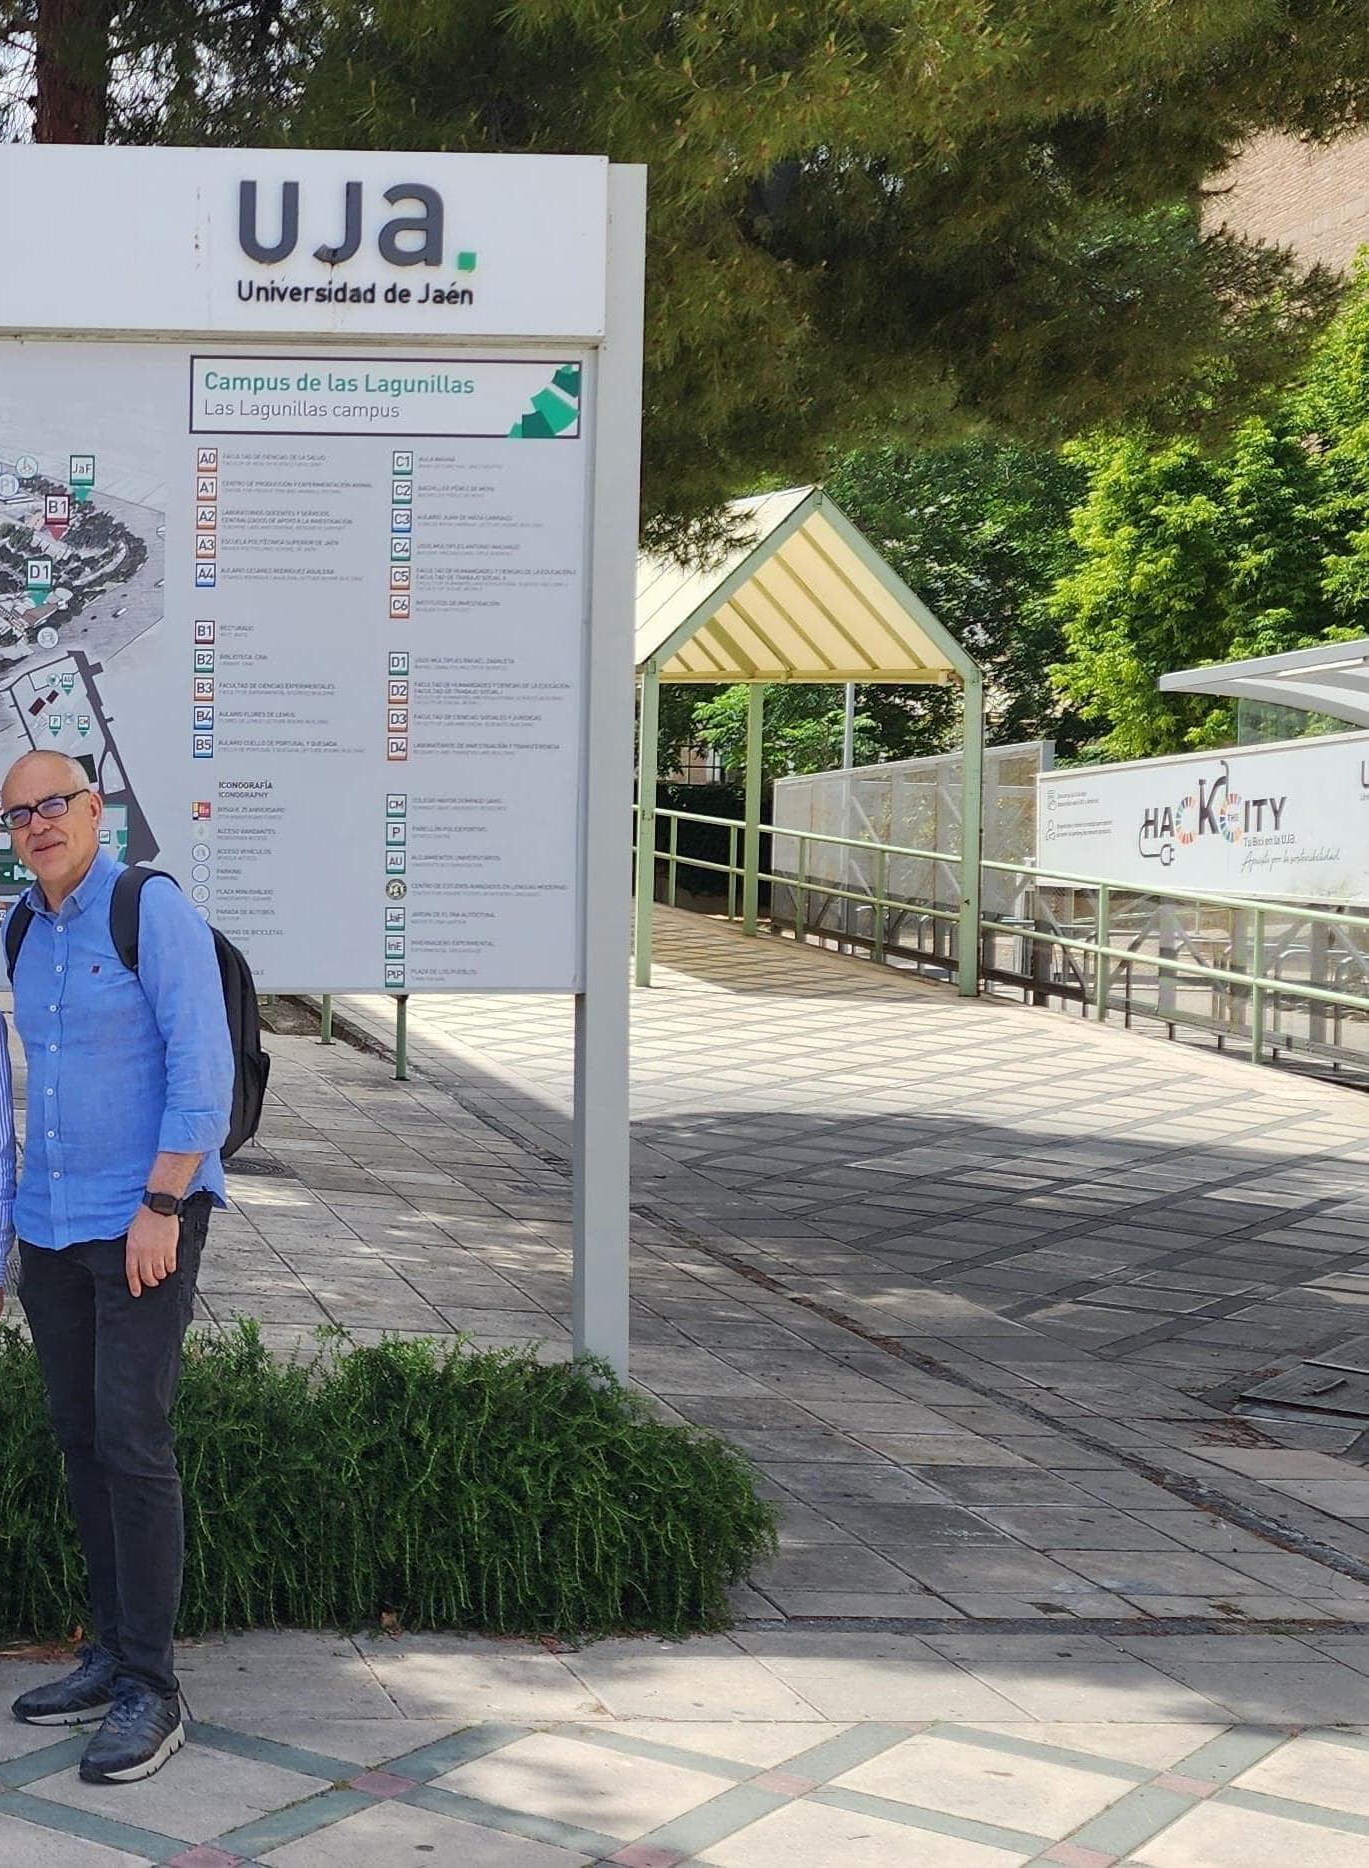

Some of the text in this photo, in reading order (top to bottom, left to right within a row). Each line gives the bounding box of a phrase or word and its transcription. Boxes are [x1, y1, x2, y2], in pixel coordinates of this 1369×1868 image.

[237, 280, 474, 305] Universidad de Jaén
[205, 371, 475, 398] Campus de las Lagunillas
[204, 399, 400, 422] Las Lagunillas campus
[199, 452, 215, 464] A0
[395, 456, 411, 467] C1
[72, 463, 92, 474] JaF
[199, 482, 215, 494] A1
[395, 485, 412, 496] C2
[49, 501, 67, 513] B1
[198, 511, 216, 522] A2
[394, 513, 411, 525] C3
[198, 539, 215, 551] A3
[393, 542, 410, 553] C4
[30, 565, 49, 579] D1
[197, 568, 214, 579] A4
[393, 571, 409, 582] C5
[392, 599, 408, 611] C6
[197, 625, 212, 636] B1
[197, 653, 213, 665] B2
[392, 656, 407, 668] D1
[197, 682, 213, 694] B3
[391, 685, 407, 696] D2
[197, 710, 212, 722] B4
[391, 713, 407, 724] D3
[196, 739, 212, 750] B5
[390, 742, 406, 753] D4
[389, 800, 404, 809] CM
[392, 827, 401, 838] P
[388, 856, 403, 866] AU
